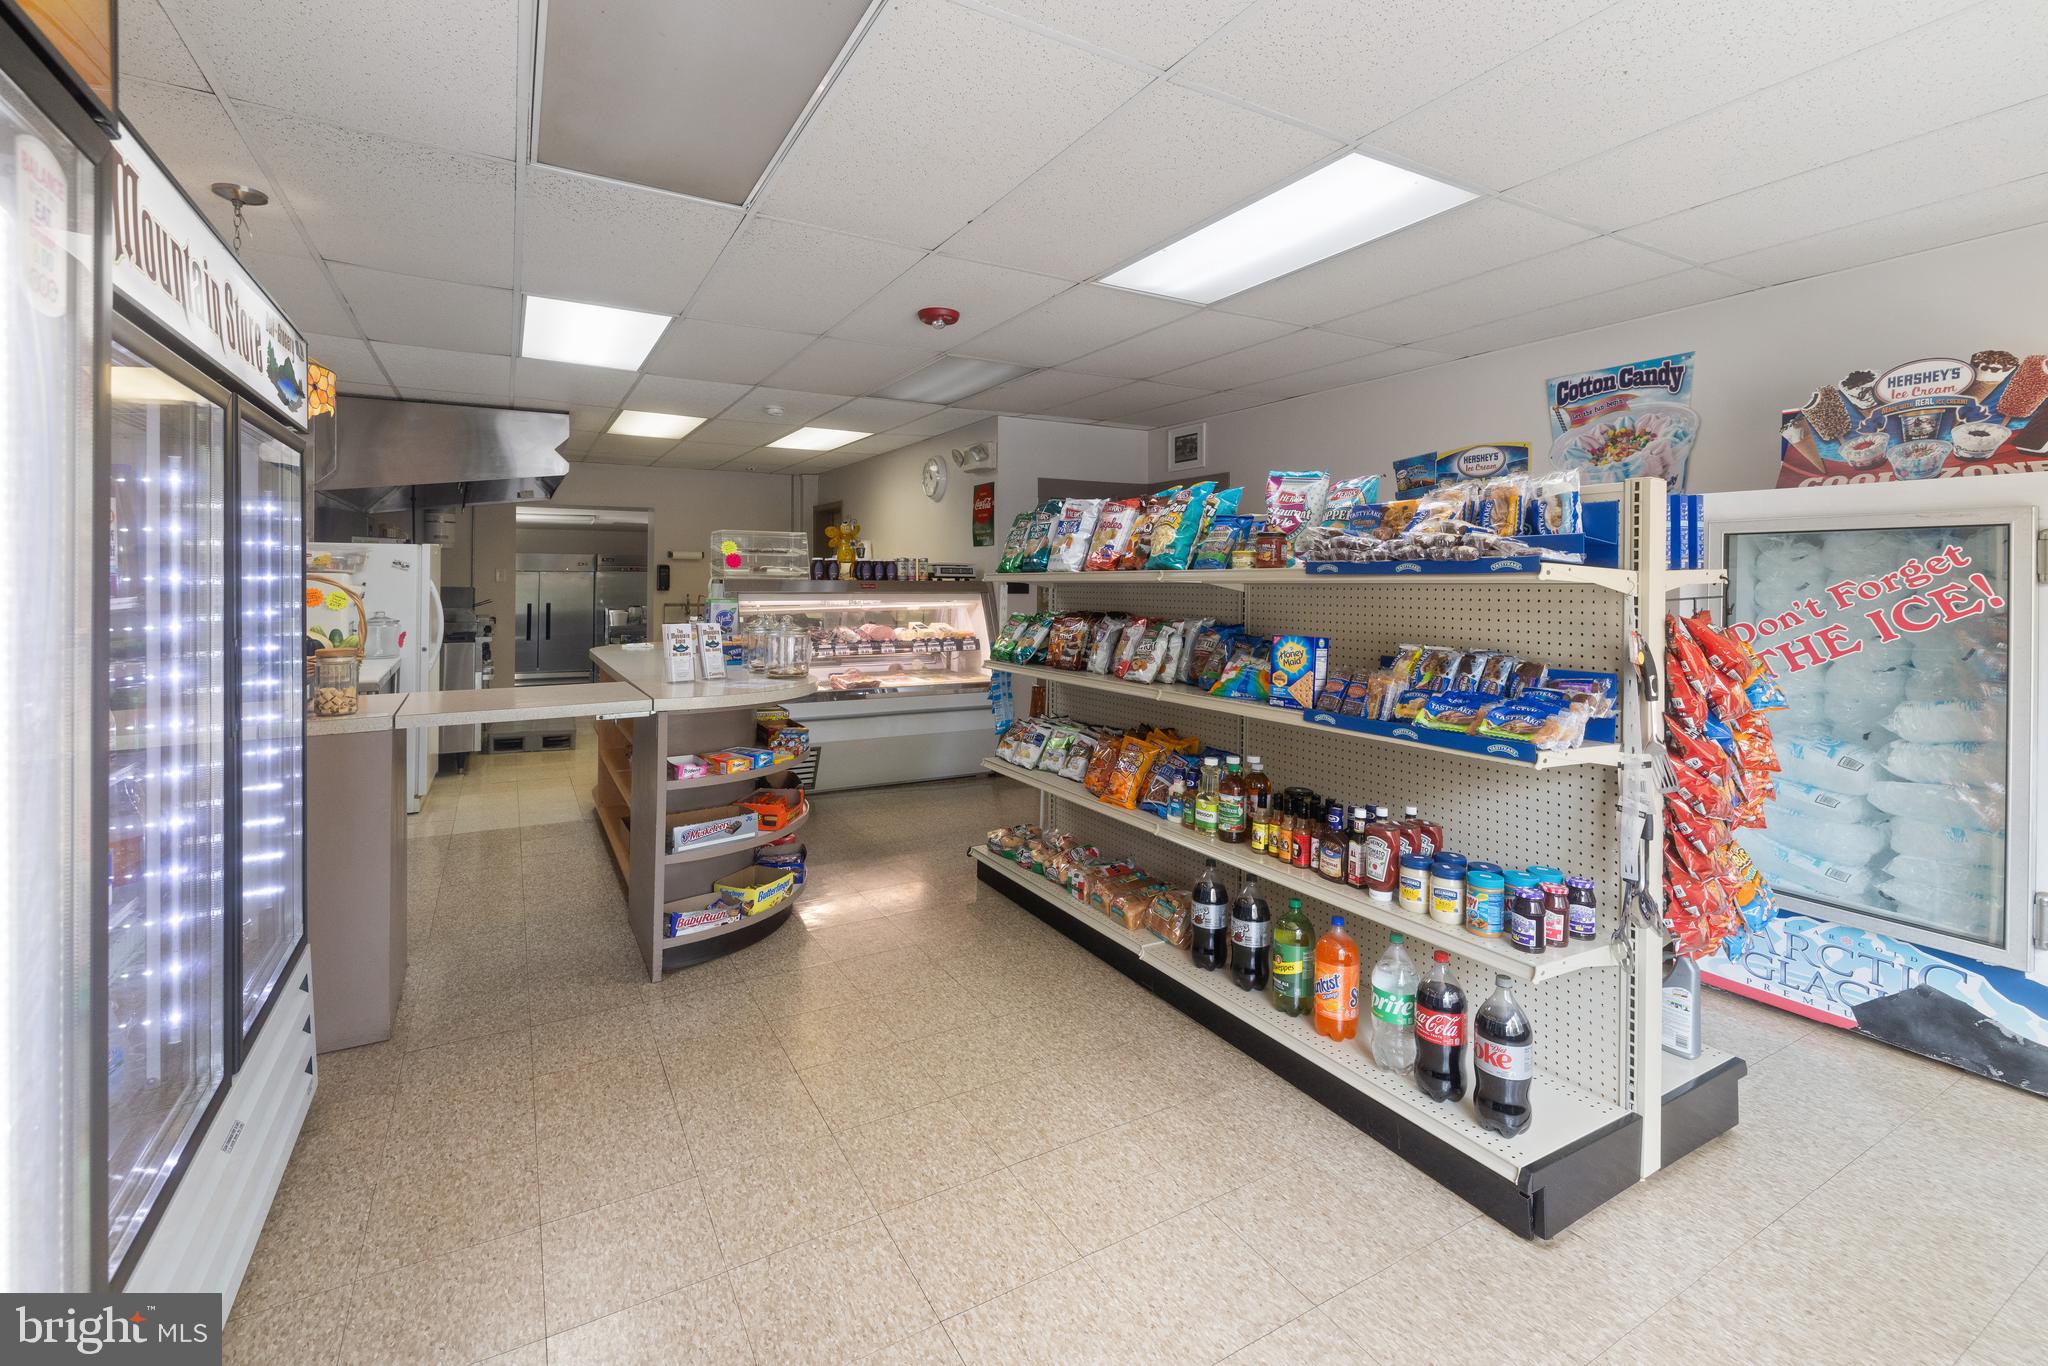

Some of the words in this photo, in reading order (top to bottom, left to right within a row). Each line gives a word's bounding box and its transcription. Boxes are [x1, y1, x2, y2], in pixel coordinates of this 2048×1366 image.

[225, 281, 264, 373] Store
[1557, 374, 1617, 406] Cotton
[1619, 361, 1685, 393] Candy
[1888, 368, 1961, 389] HERSHEY'S
[1891, 389, 1908, 400] Ice
[1912, 385, 1956, 397] Cream
[1607, 399, 1623, 409] begin
[1915, 398, 1935, 407] REAL
[1463, 452, 1499, 464] HERSHEY'S
[1475, 464, 1497, 472] Cream
[1279, 492, 1306, 504] HERR'S
[1490, 561, 1523, 571] TASTYKAKE
[1727, 596, 1828, 645] Don't
[1826, 544, 1973, 611] Forget
[1755, 623, 1864, 680] THE
[1864, 572, 2006, 645] ICE!
[1280, 648, 1304, 660] Honey
[1283, 657, 1302, 667] Maid
[1487, 744, 1520, 758] TASTYKAKE
[690, 821, 729, 841] Musketeers
[1368, 846, 1386, 856] TOMATO
[1369, 839, 1384, 848] HEINZ
[757, 879, 790, 902] Butterfinger
[1752, 927, 1968, 990] ARCTIC
[1744, 951, 1889, 1007] GLAC
[1372, 992, 1413, 1016] prite
[1415, 1010, 1461, 1037] ca-Cola
[1474, 1041, 1512, 1070] oke
[1491, 1044, 1507, 1053] Diet
